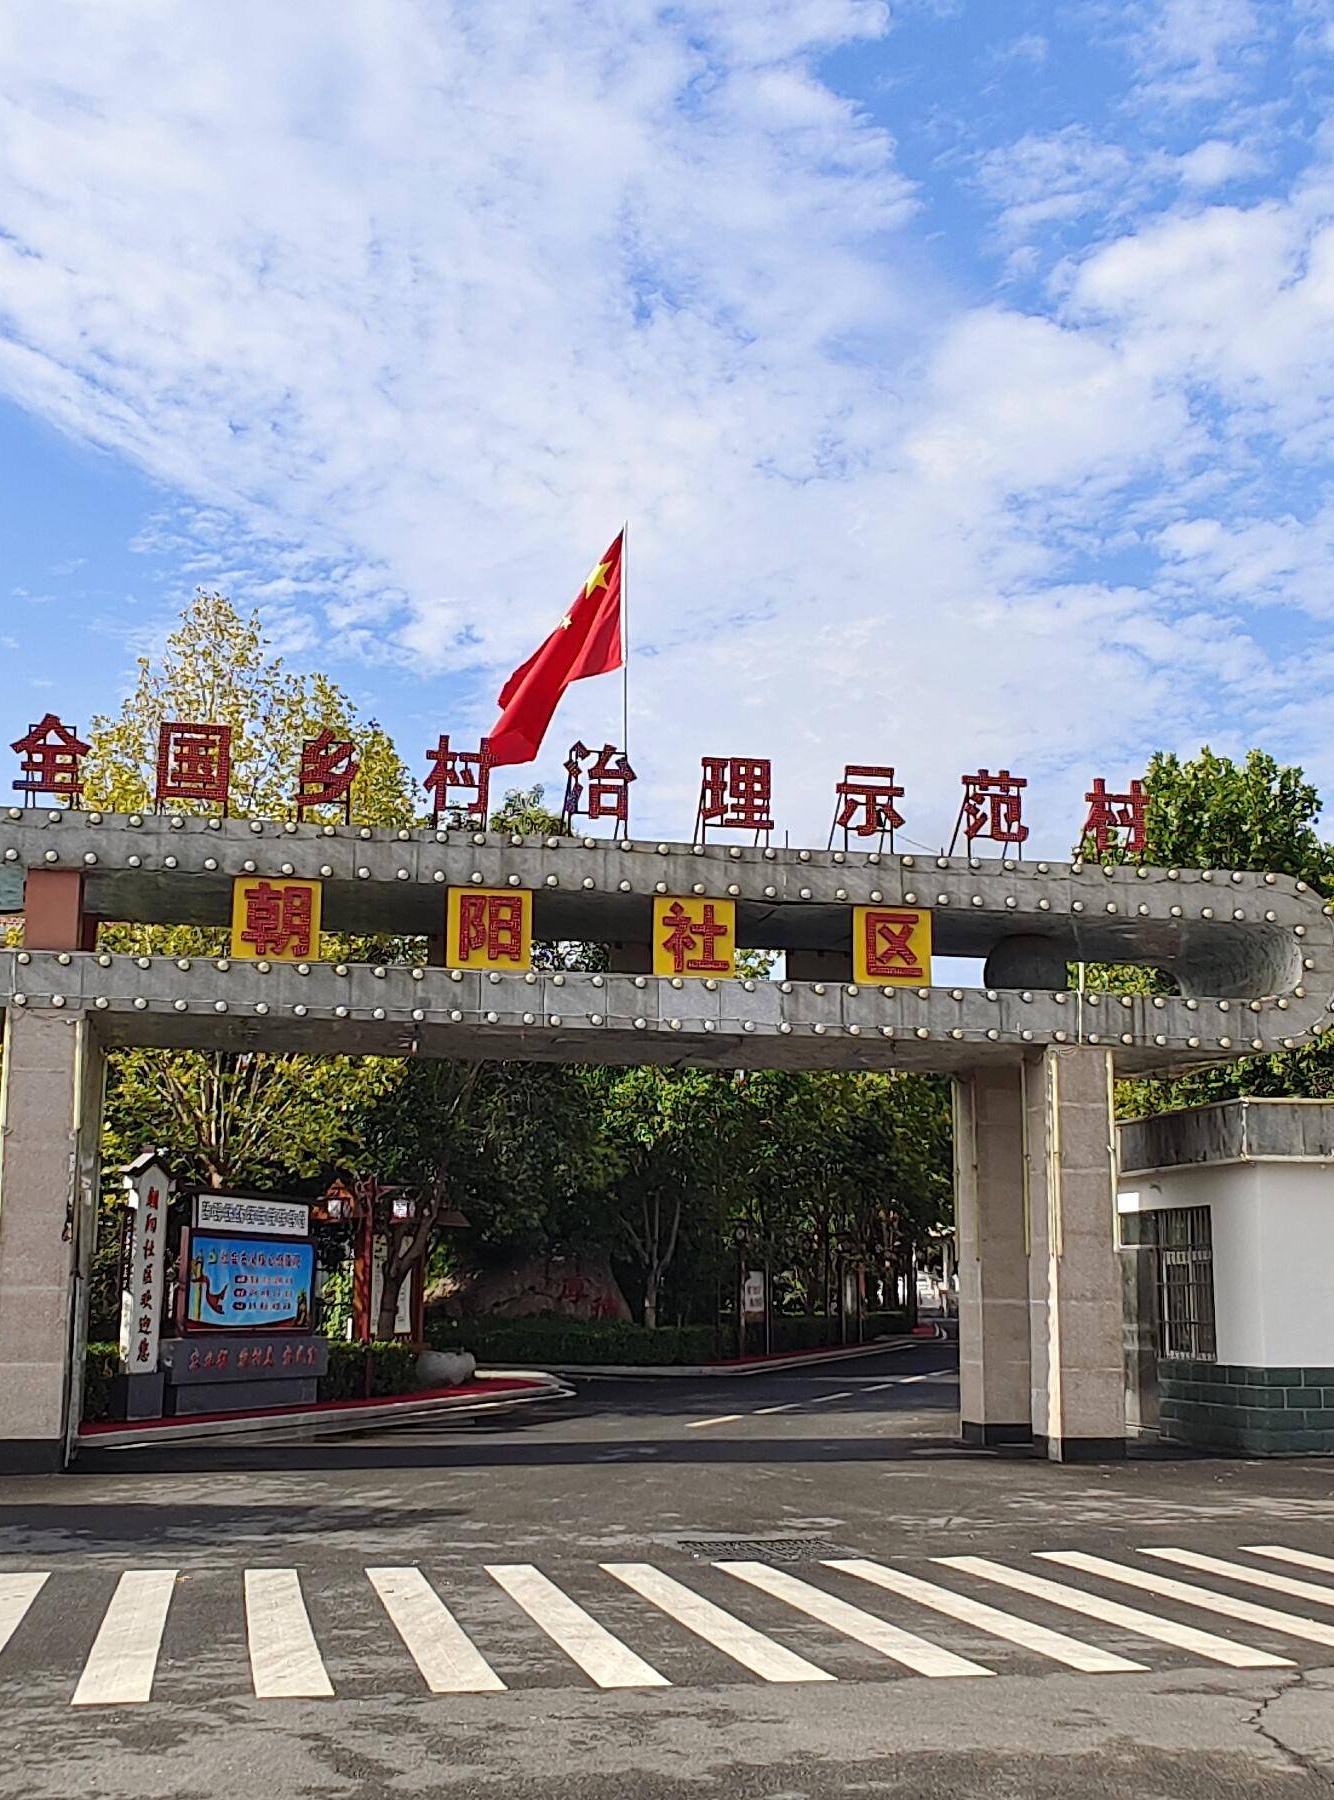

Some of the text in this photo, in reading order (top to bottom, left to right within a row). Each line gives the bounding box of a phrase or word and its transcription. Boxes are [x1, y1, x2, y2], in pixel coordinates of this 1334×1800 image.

[10, 713, 1150, 853] 全国乡村治理示范村
[241, 881, 923, 977] 朝阳社区
[136, 1186, 160, 1363] 朝阳社区欢迎您
